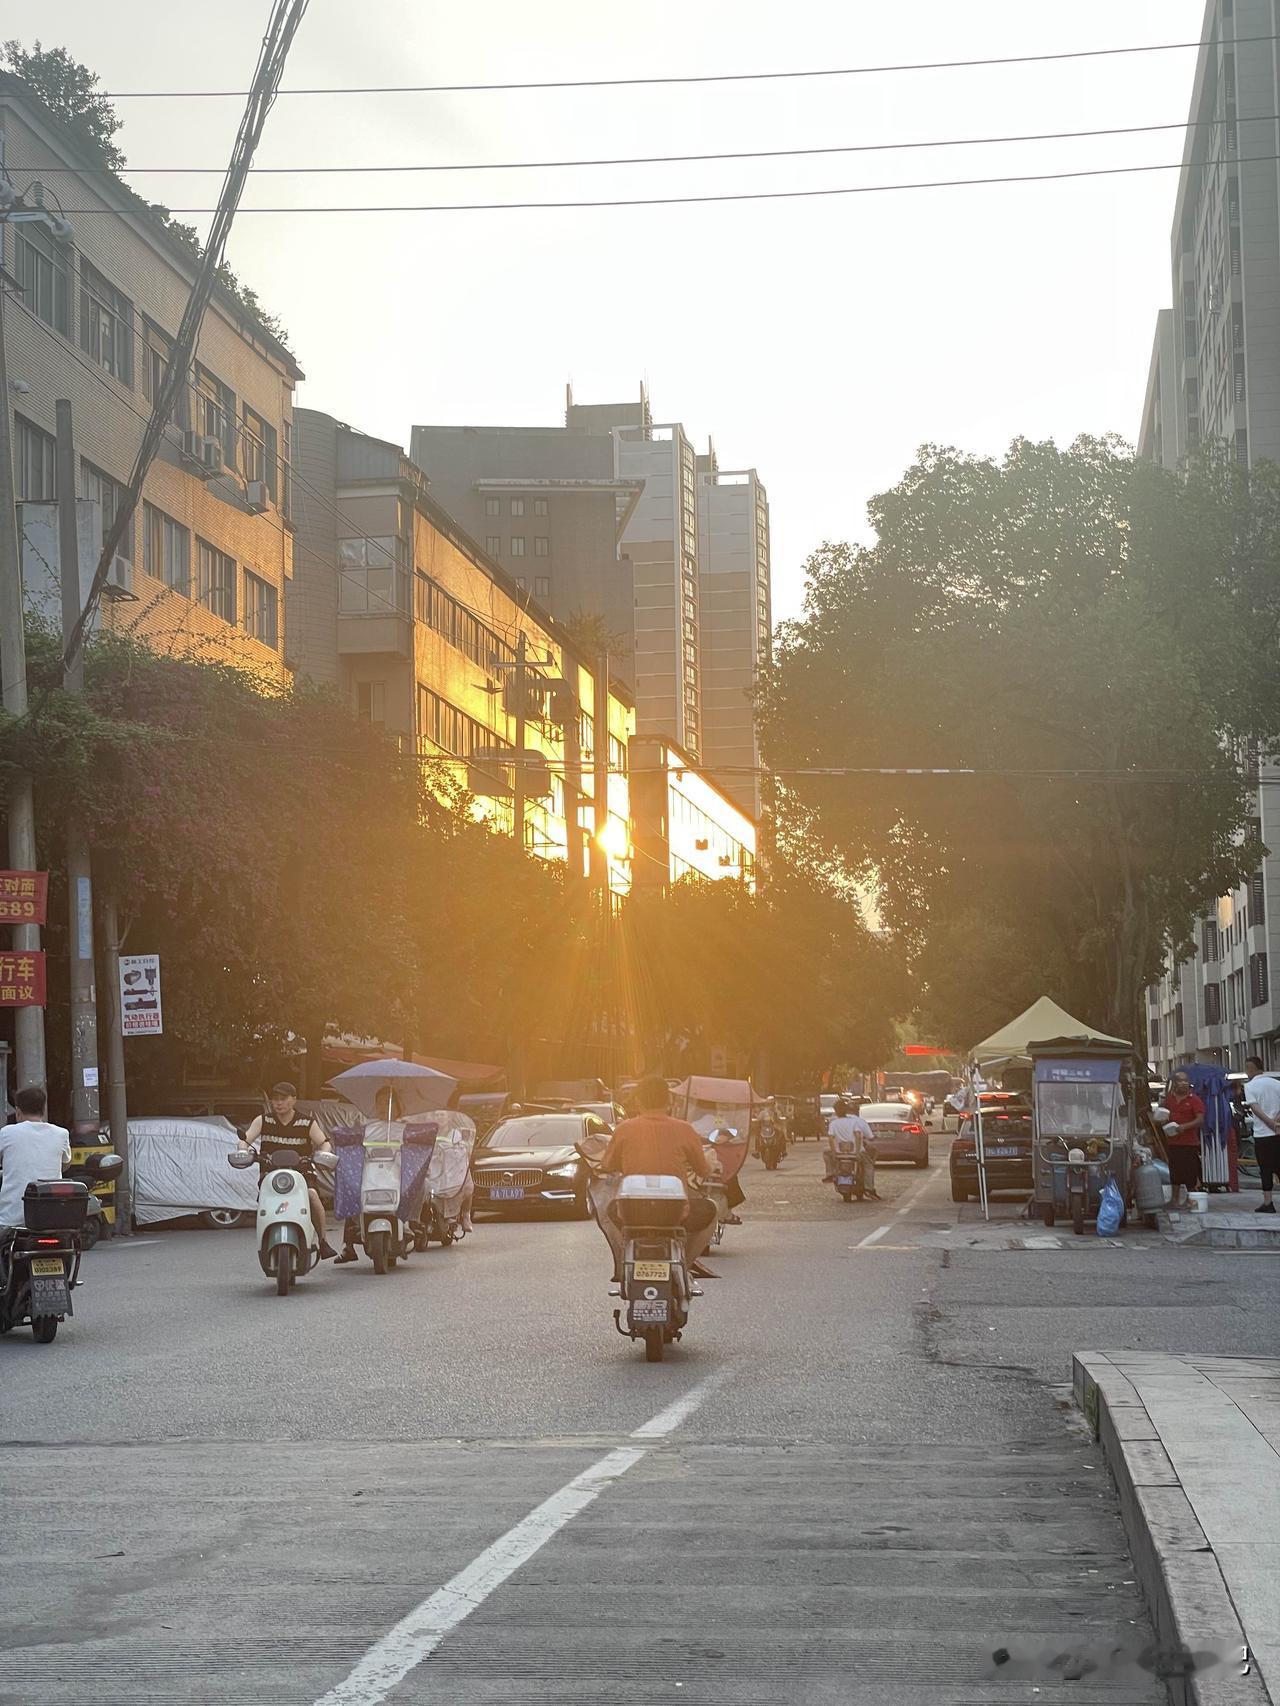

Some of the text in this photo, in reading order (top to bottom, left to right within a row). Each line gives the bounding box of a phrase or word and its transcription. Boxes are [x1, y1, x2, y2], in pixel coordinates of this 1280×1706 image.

[0, 877, 35, 897] 对面
[0, 957, 35, 981] 行车
[1, 985, 34, 1001] 面议
